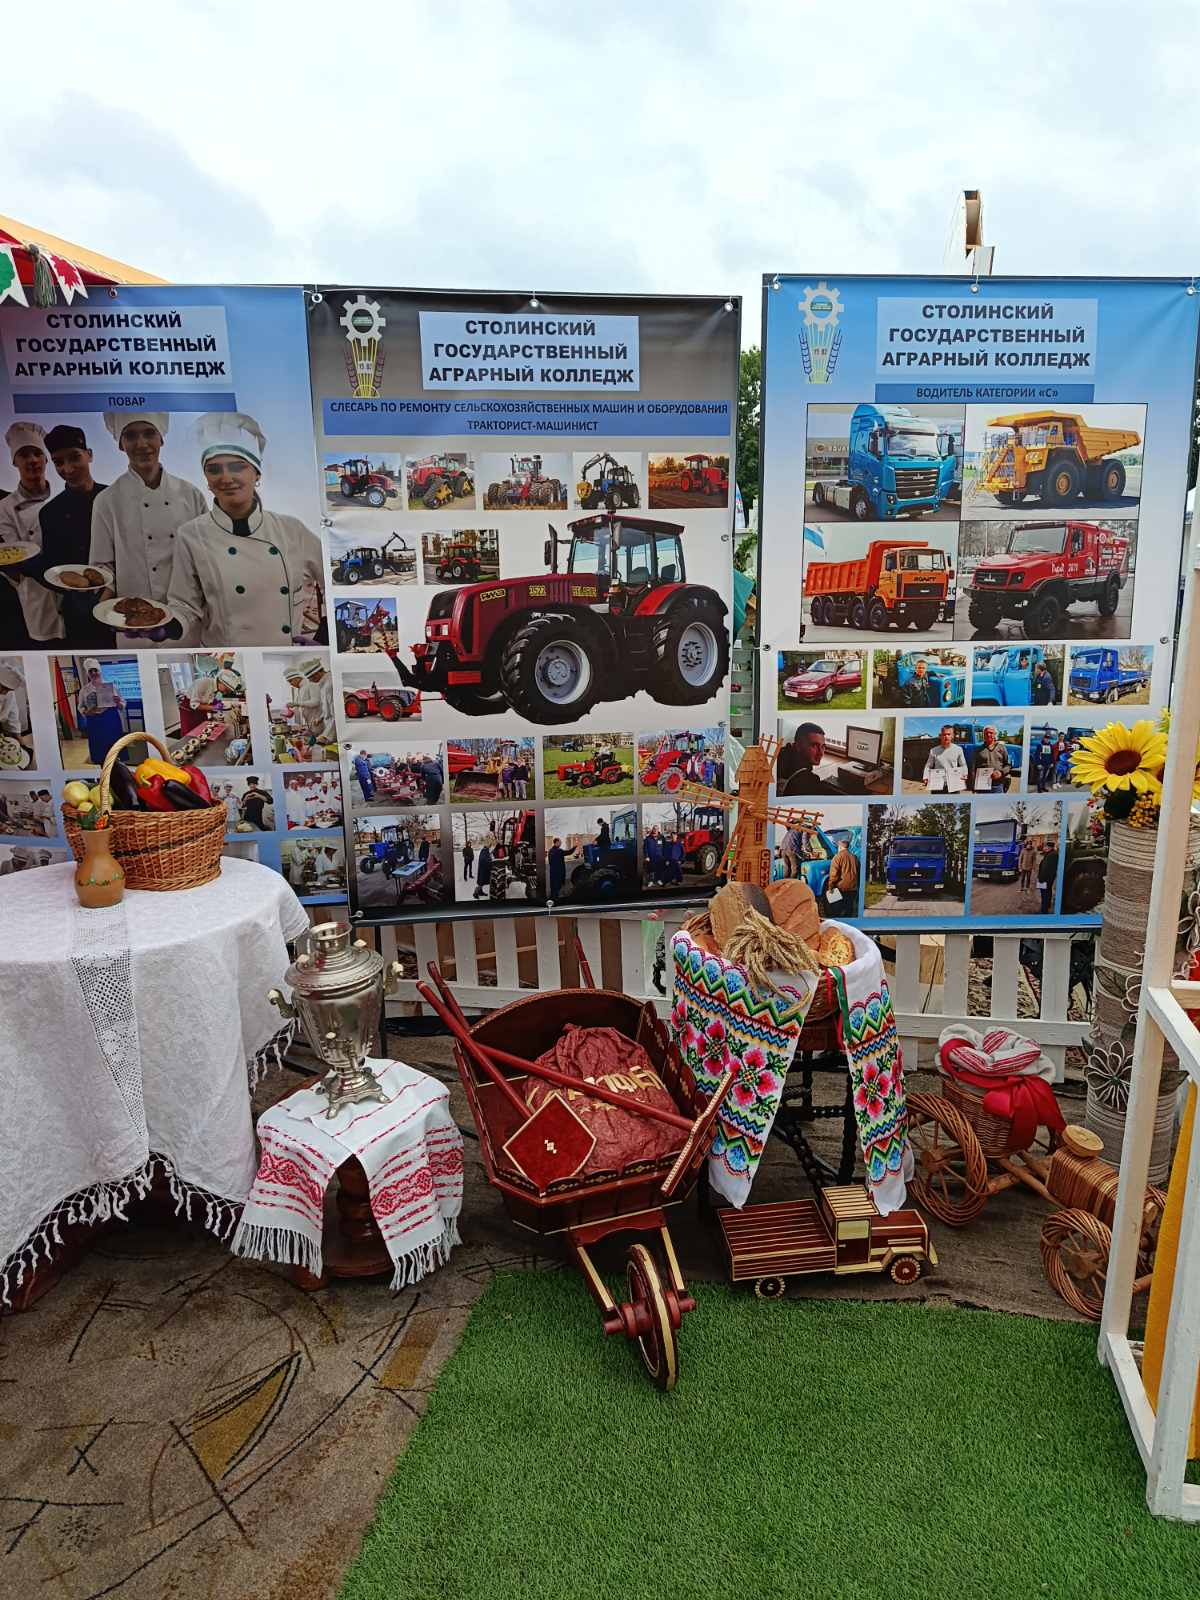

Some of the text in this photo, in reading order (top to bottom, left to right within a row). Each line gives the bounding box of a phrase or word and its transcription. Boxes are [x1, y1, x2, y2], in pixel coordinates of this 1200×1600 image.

[46, 311, 182, 329] СТОЛИНСКИЙ
[922, 303, 1054, 320] СТОЛИНСКИЙ
[465, 320, 596, 336] СТОЛИНСКИЙ
[889, 327, 1085, 345] ГОСУДАРСТВЕННЫЙ
[16, 335, 217, 355] ГОСУДАРСТВЕННЫЙ
[433, 343, 628, 362] ГОСУДАРСТВЕННЫЙ
[882, 349, 1090, 369] АГРАРНЫЙ КОЛЛЕДЖ
[15, 358, 226, 379] АГРАРНЫЙ КОЛЛЕДЖ
[429, 365, 634, 385] АГРАРНЫЙ КОЛЛЕДЖ
[108, 396, 146, 407] ПОВАР
[916, 387, 1058, 399] ВОДИТЕЛЬ КАТЕГОРИИ «С»
[330, 402, 728, 415] СЛЕСАРЬ ПО РЕМОНТУ СЕЛЬСКОХОЗЯЙСТВЕННЫХ МАШИН И ОБОРУДОВАНИЯ
[467, 420, 598, 431] ТРАКТОРИСТ-МАШИНИСТ
